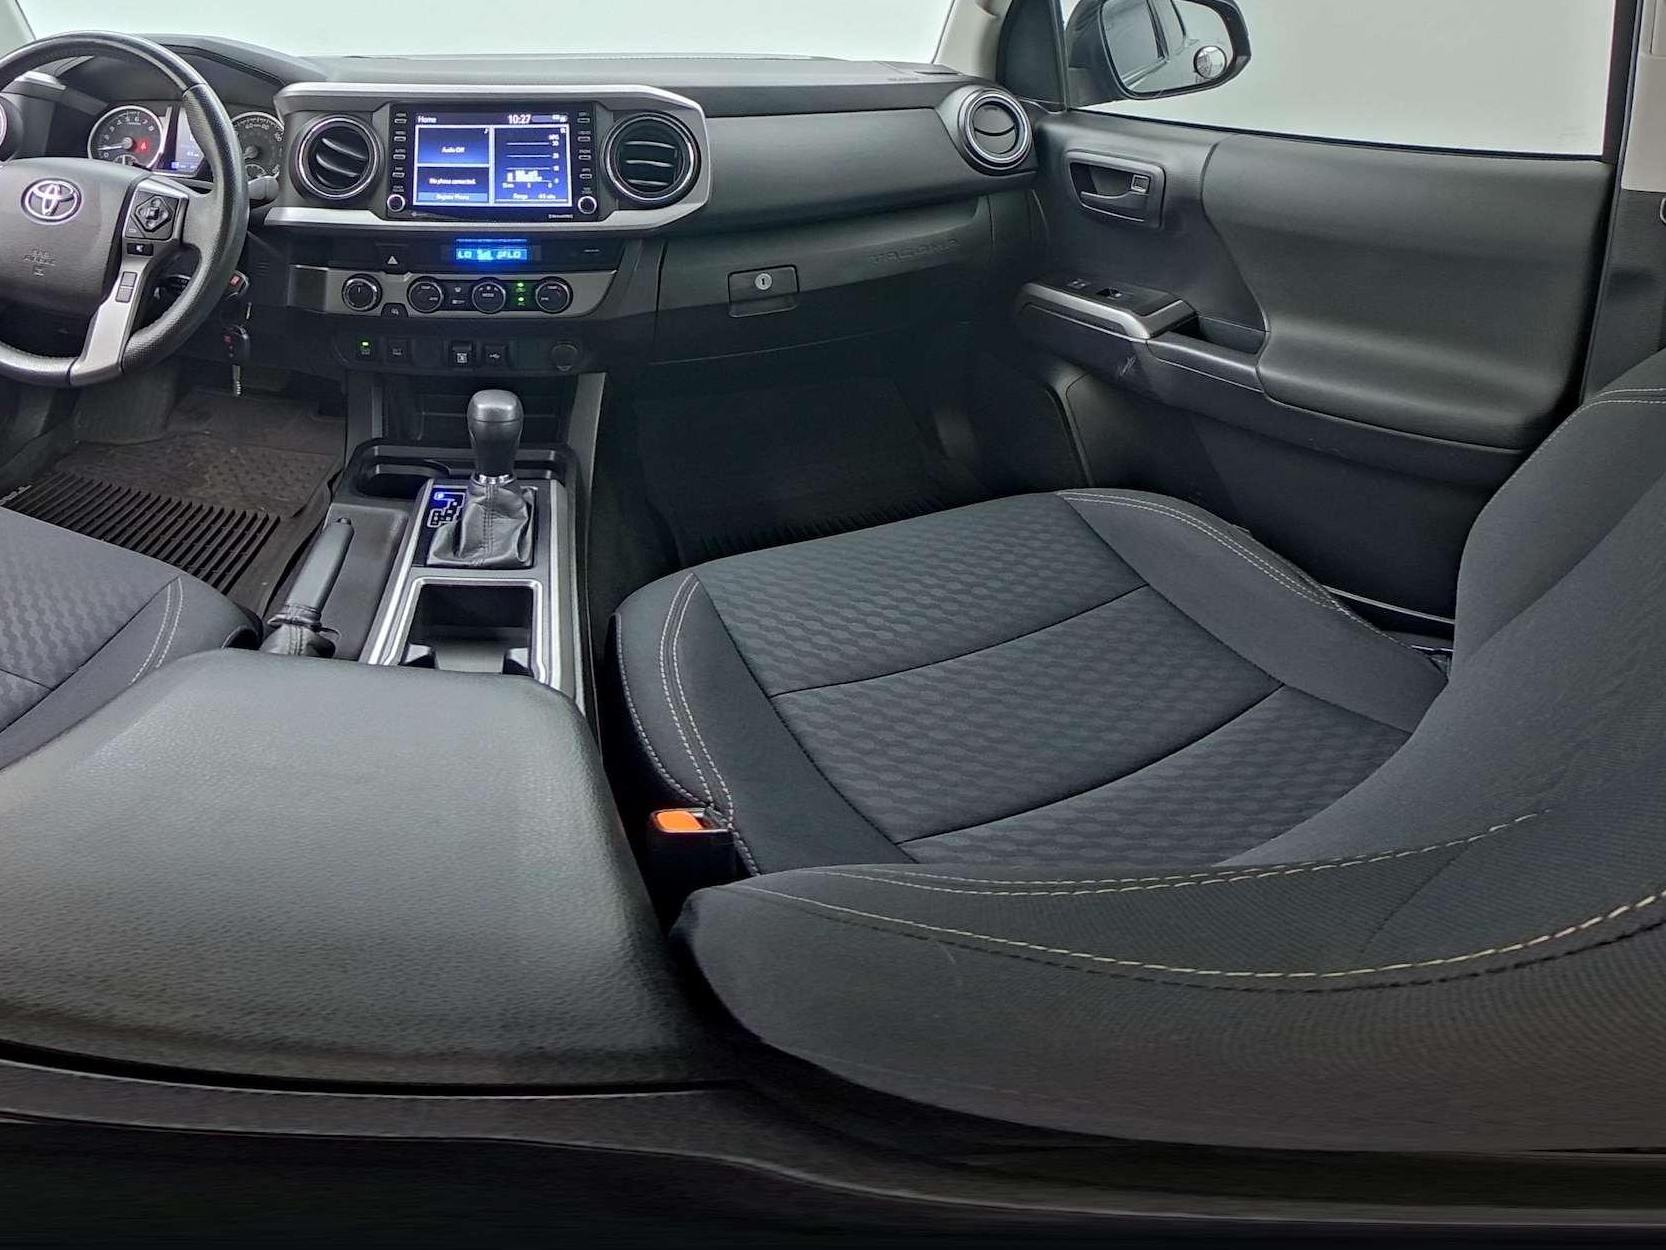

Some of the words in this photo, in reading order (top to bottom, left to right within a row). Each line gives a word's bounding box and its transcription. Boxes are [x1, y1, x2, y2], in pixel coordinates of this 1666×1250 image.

[417, 115, 437, 123] Home
[508, 114, 531, 124] 10:27
[458, 250, 472, 258] LO
[507, 250, 521, 258] LO
[868, 238, 959, 263] TACOMA
